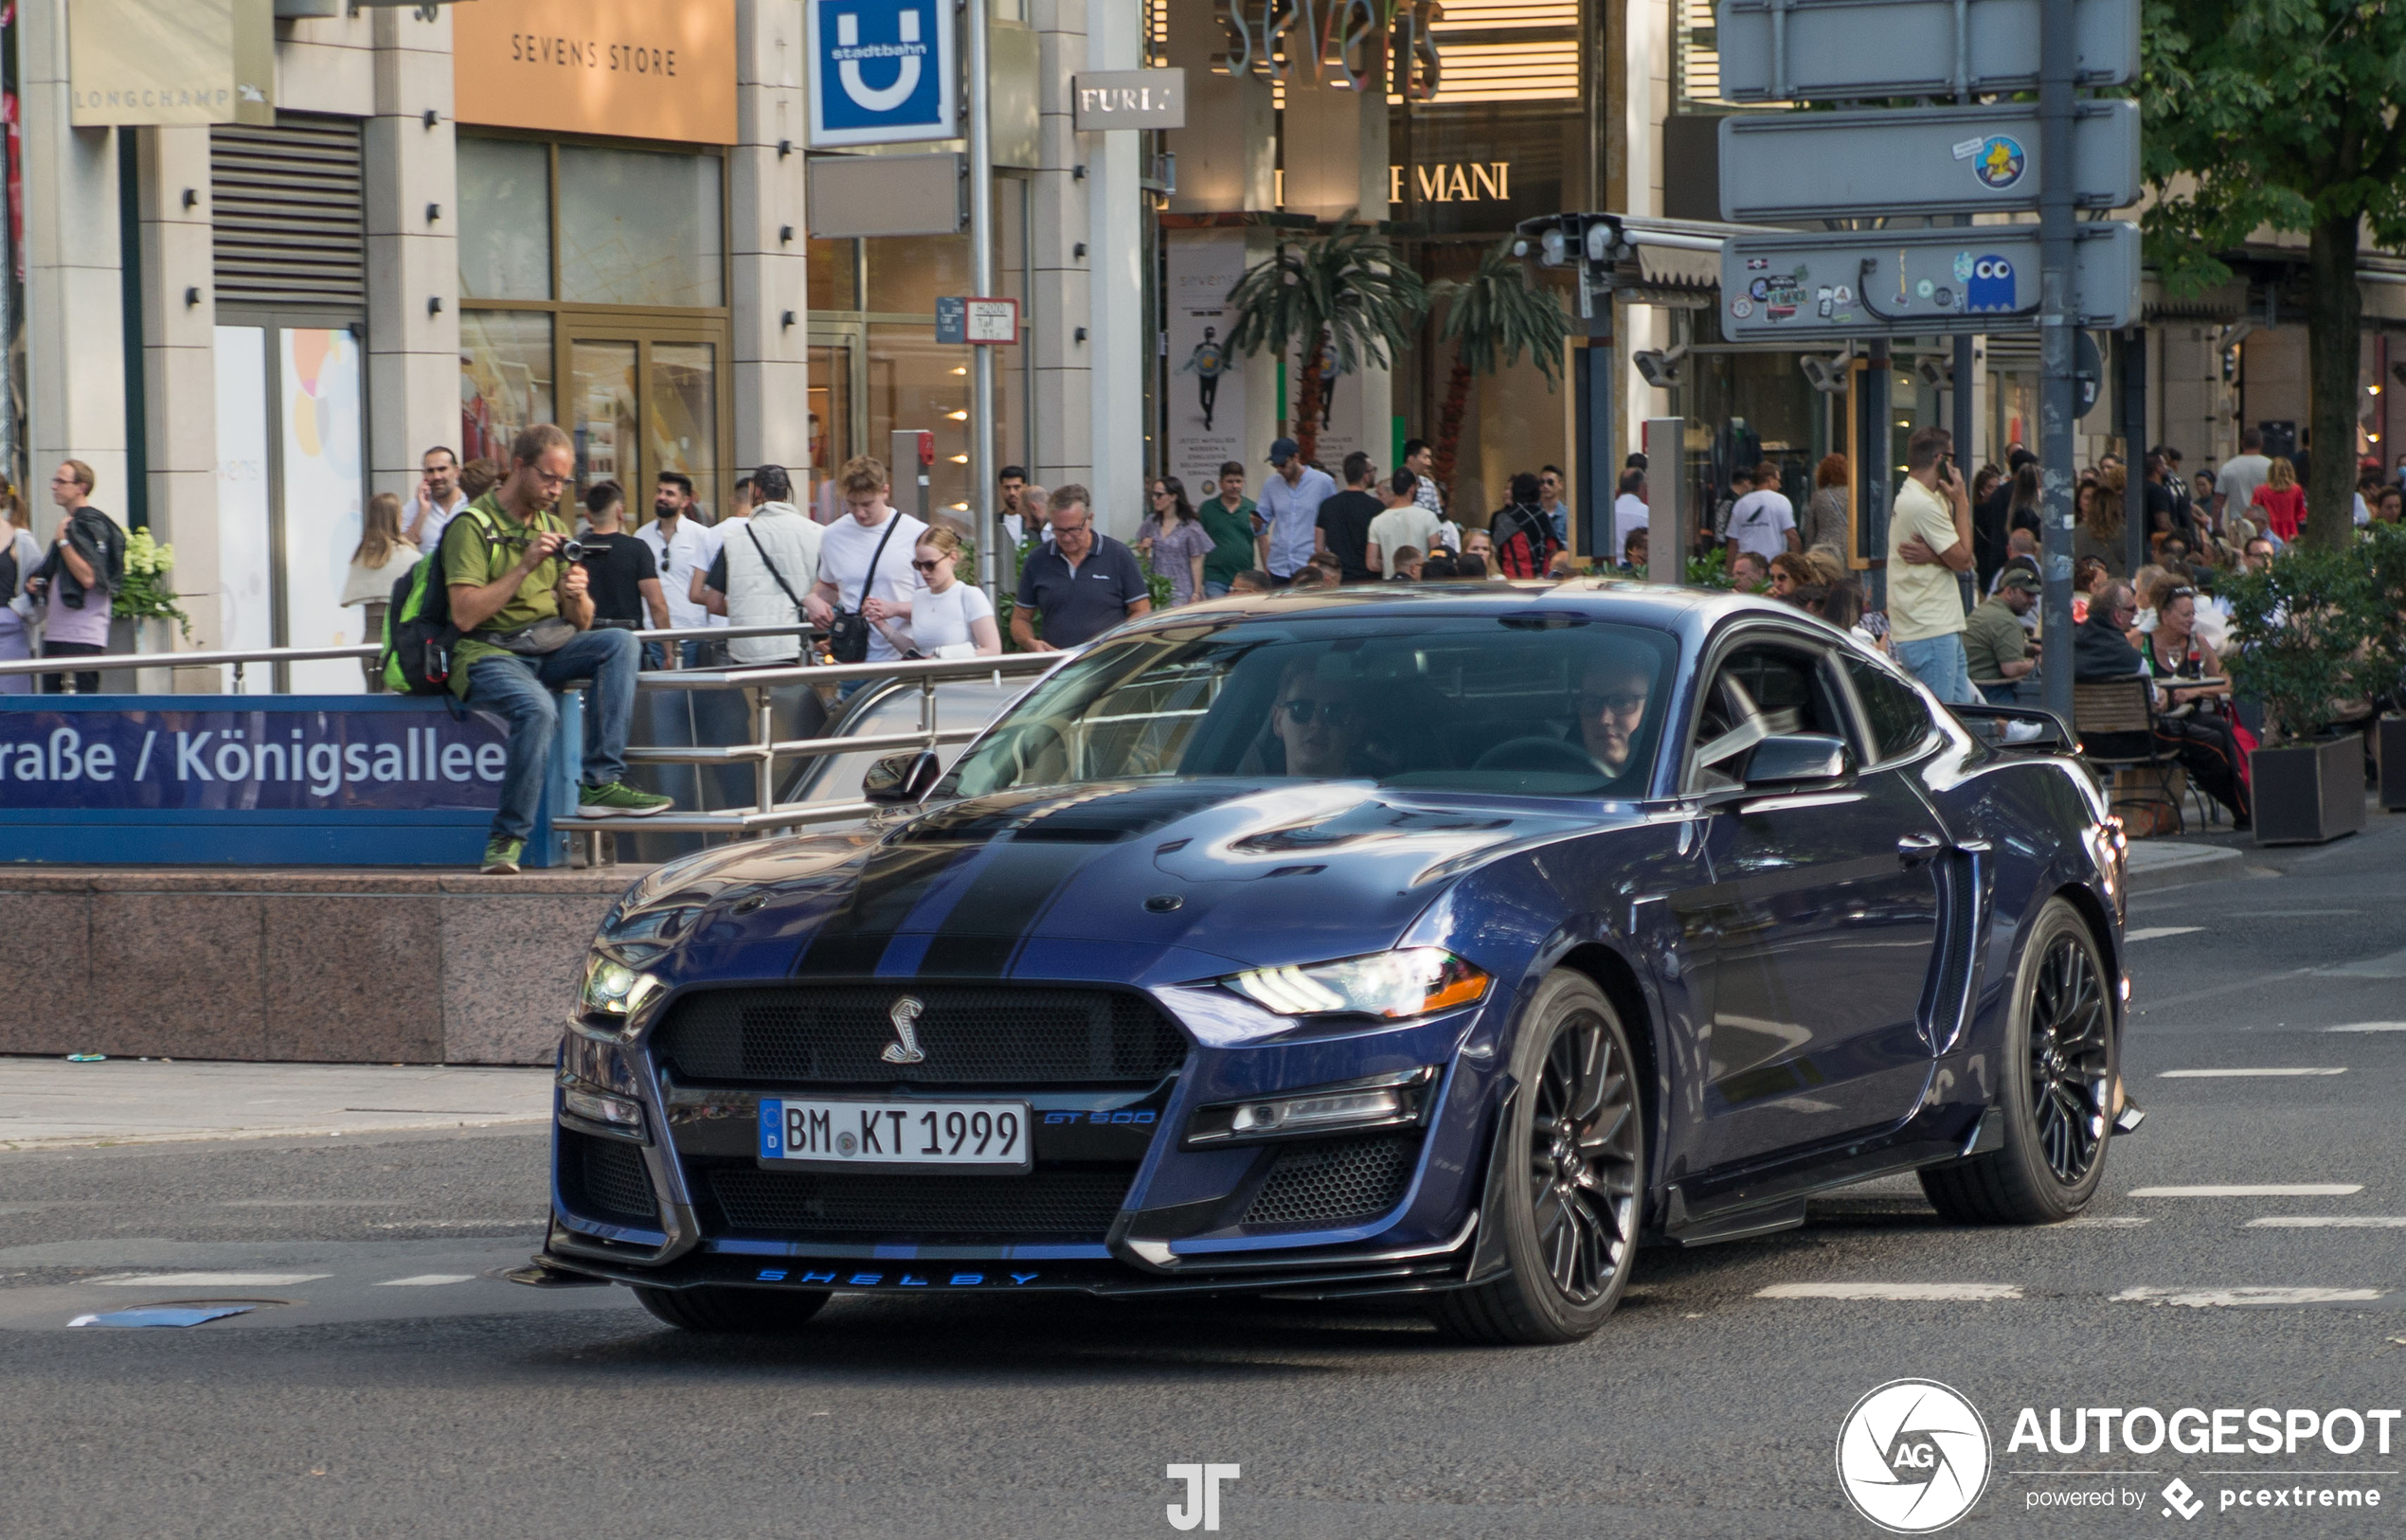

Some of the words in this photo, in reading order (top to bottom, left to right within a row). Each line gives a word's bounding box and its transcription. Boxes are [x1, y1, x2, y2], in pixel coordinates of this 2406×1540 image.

[512, 33, 597, 68] SEVENS
[610, 44, 676, 77] STORE
[832, 43, 927, 60] stadtbahn
[75, 89, 229, 108] LONGCHAMP
[134, 730, 157, 781] /
[176, 727, 507, 797] Königsallee
[1043, 1112, 1078, 1124] GT
[1088, 1111, 1157, 1124] 500
[785, 1107, 831, 1153] BM
[861, 1110, 907, 1155] KT
[921, 1110, 1019, 1155] 1999
[767, 1135, 778, 1149] D
[756, 1269, 1039, 1286] SHELBY
